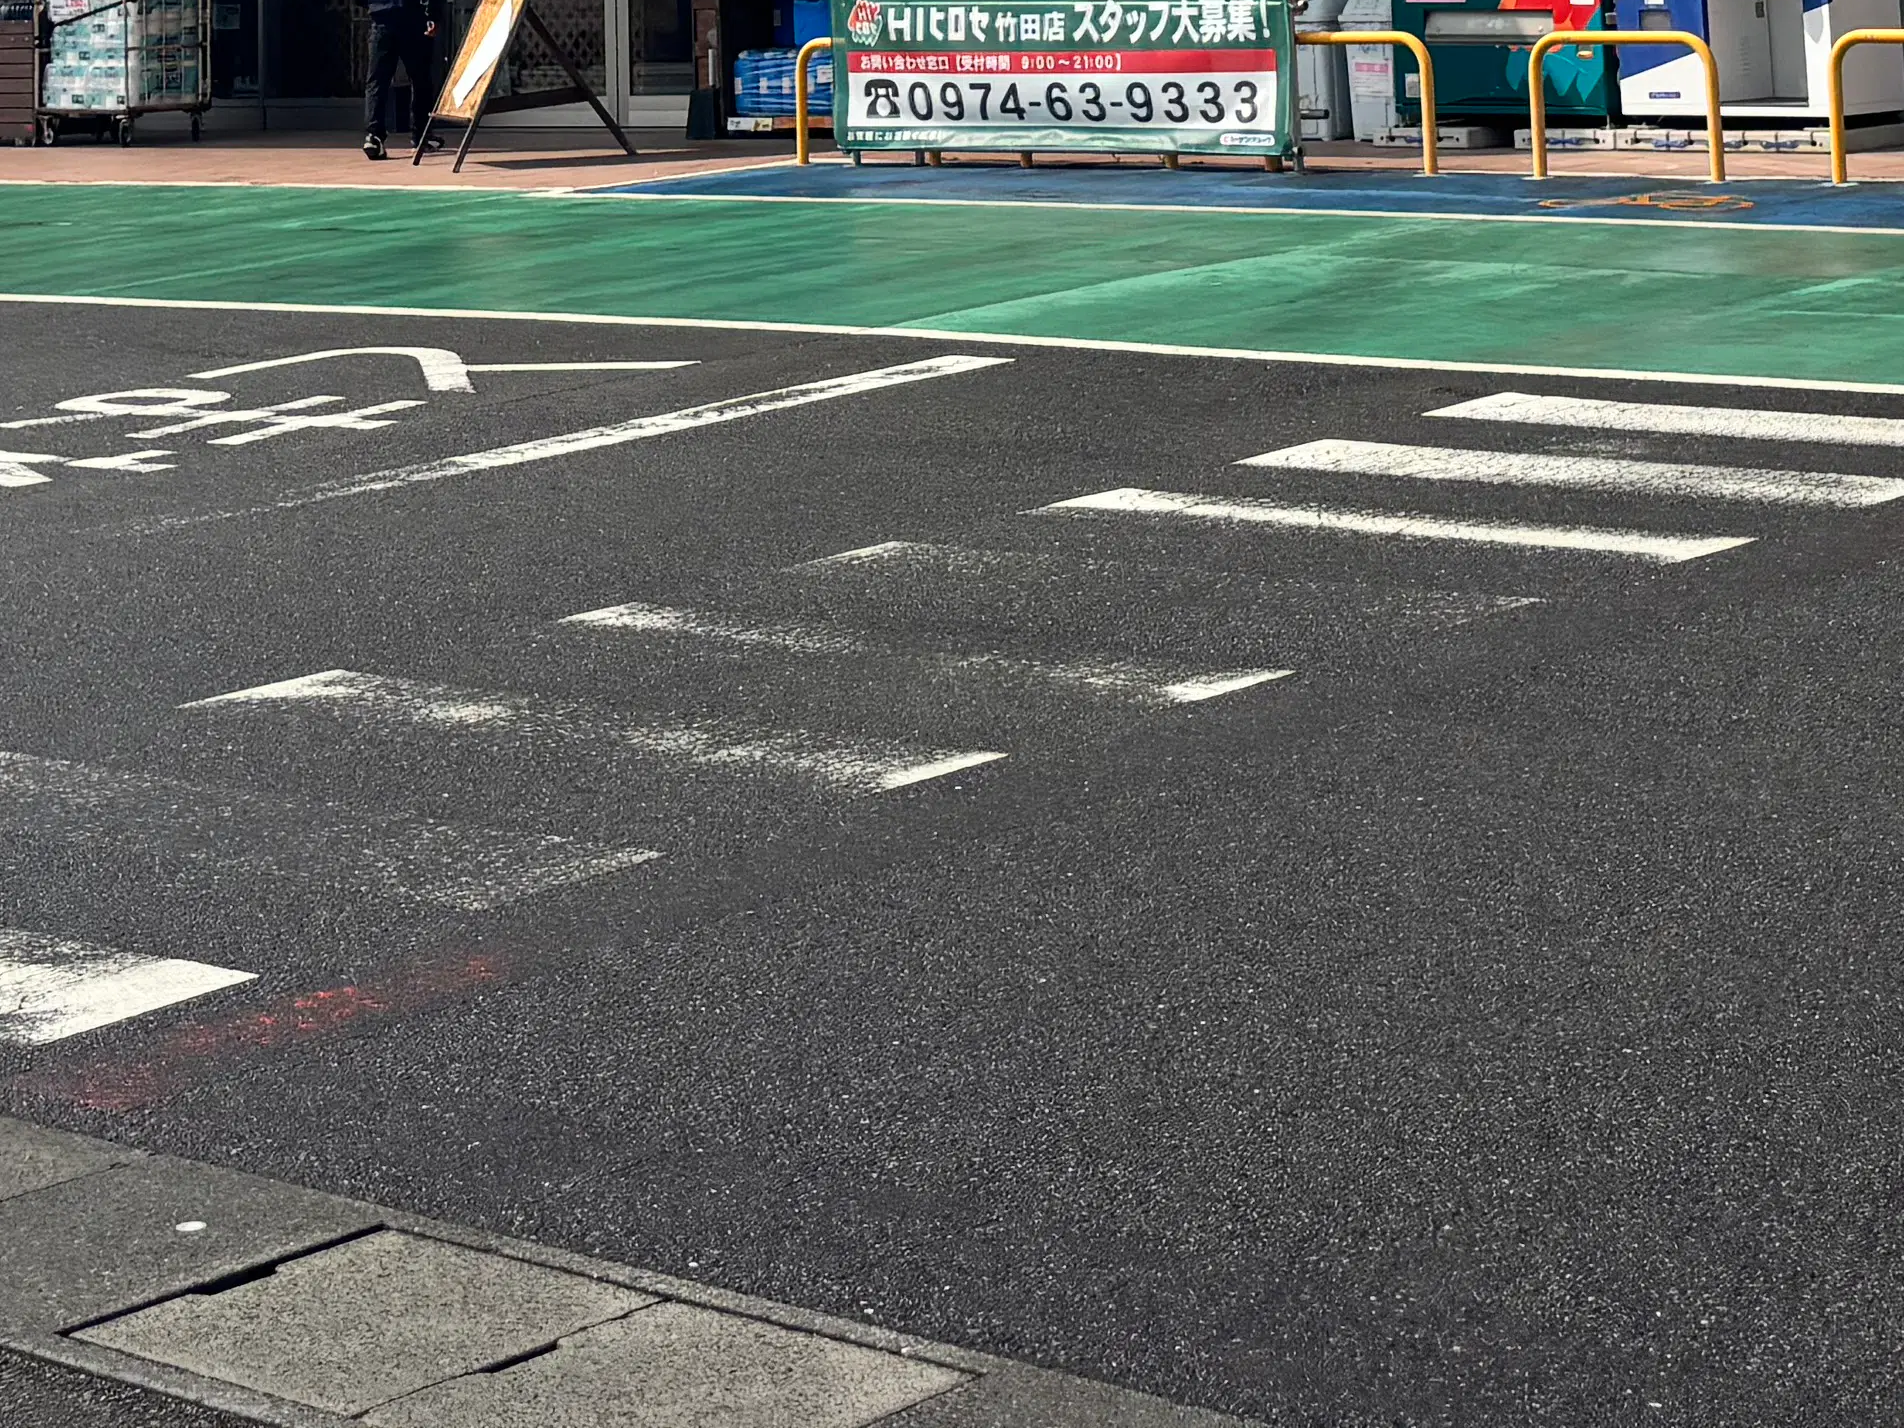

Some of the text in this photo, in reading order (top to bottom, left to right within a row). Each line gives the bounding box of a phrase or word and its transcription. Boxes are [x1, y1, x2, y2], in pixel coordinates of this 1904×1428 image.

[994, 14, 1066, 42] 竹田店
[860, 55, 950, 71] お問い合わせ窓口
[908, 80, 1258, 124] 0974-63-9333
